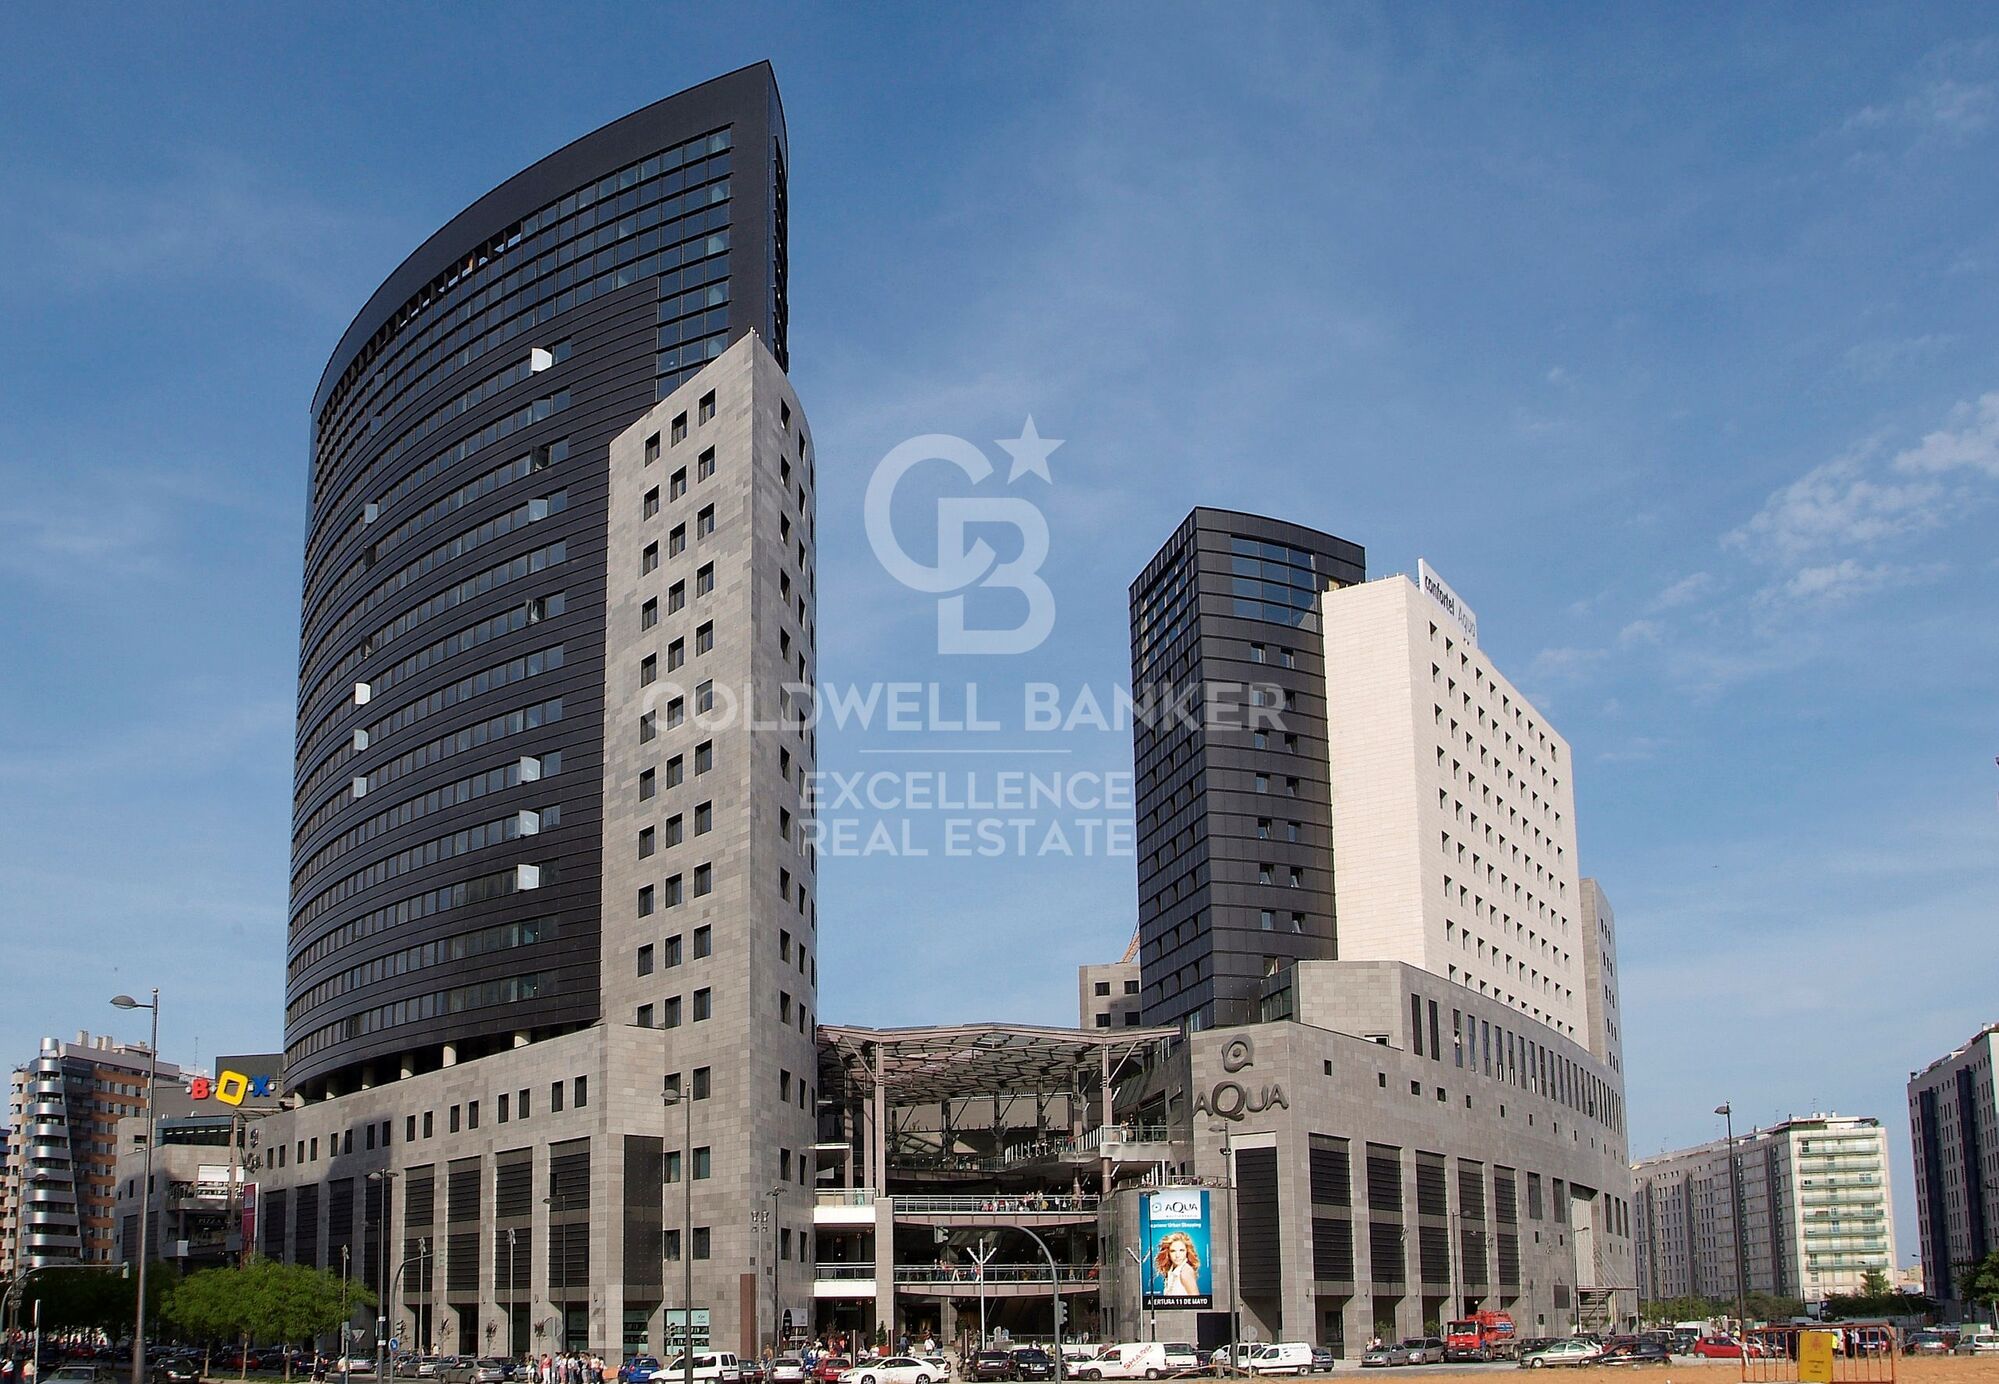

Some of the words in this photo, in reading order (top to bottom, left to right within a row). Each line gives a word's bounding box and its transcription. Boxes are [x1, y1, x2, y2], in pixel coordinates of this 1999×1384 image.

[191, 1070, 270, 1107] BOX
[1193, 1080, 1289, 1122] AQUA
[1164, 1201, 1198, 1214] AQUA
[1147, 1298, 1175, 1306] AERTURA
[1123, 1344, 1152, 1370] SHARP
